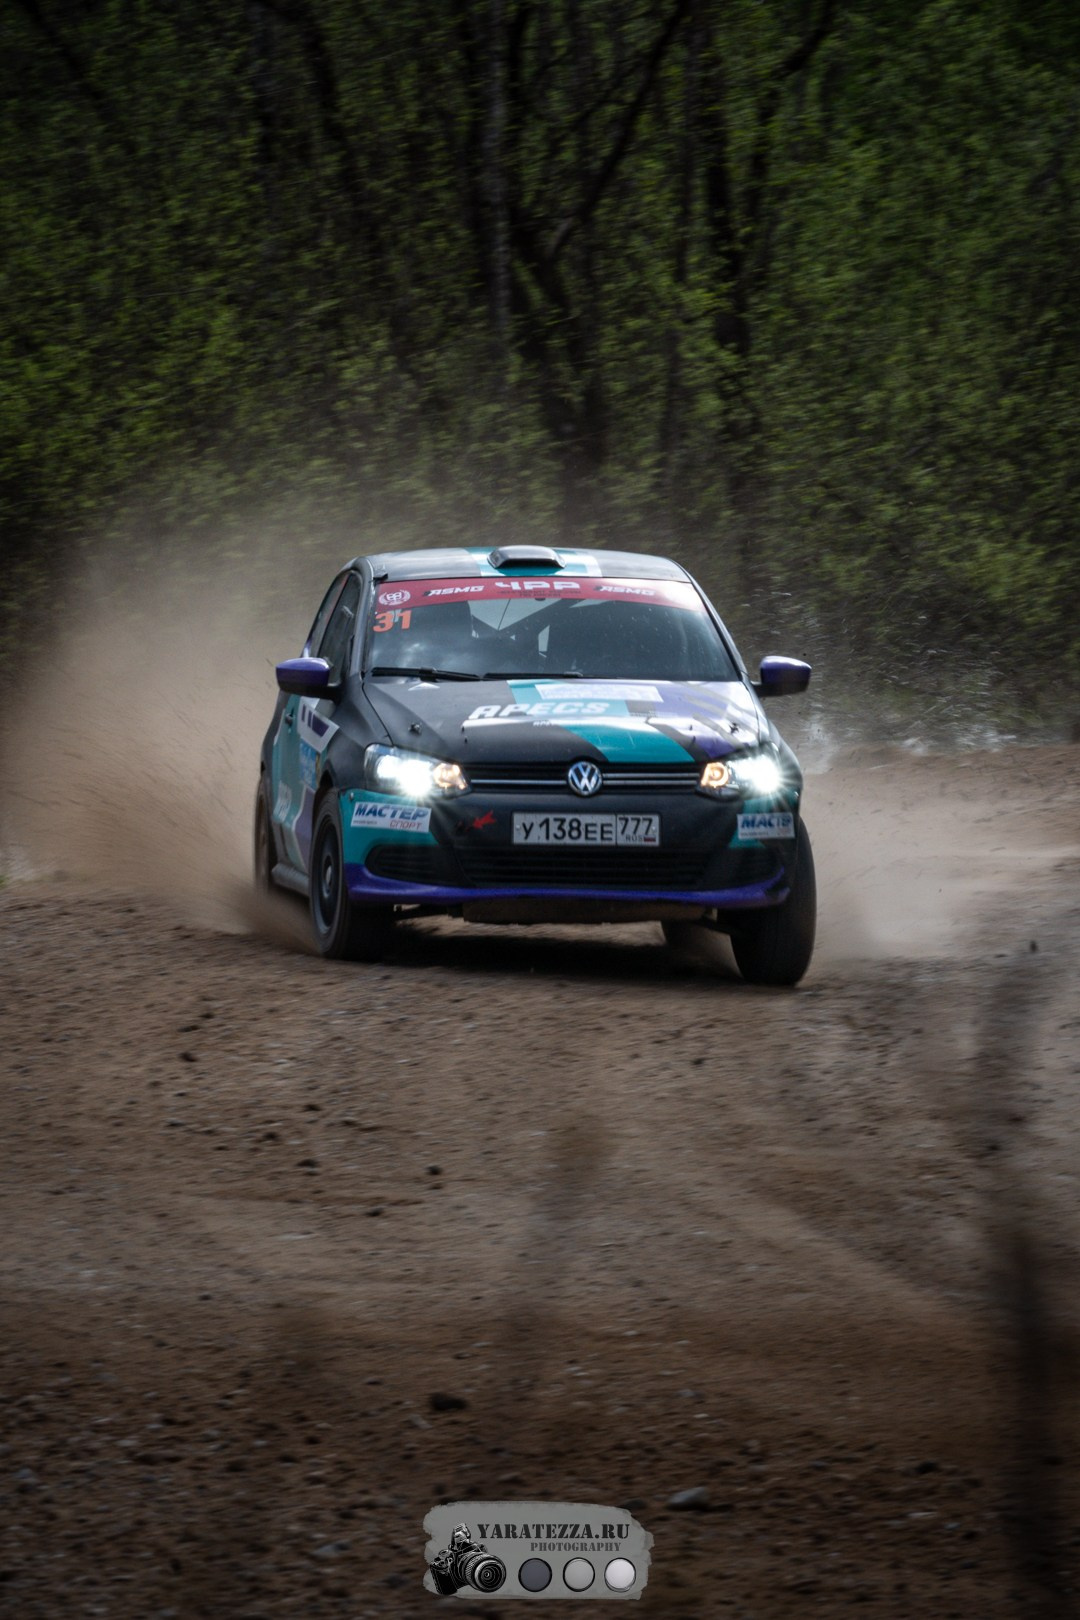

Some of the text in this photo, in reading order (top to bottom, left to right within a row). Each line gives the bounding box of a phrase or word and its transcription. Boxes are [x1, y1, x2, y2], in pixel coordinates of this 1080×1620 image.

[372, 610, 412, 632] 31
[468, 701, 611, 720] APECS
[354, 802, 429, 821] МАСТЕР
[389, 819, 423, 830] СПОРТ
[618, 816, 653, 836] 777
